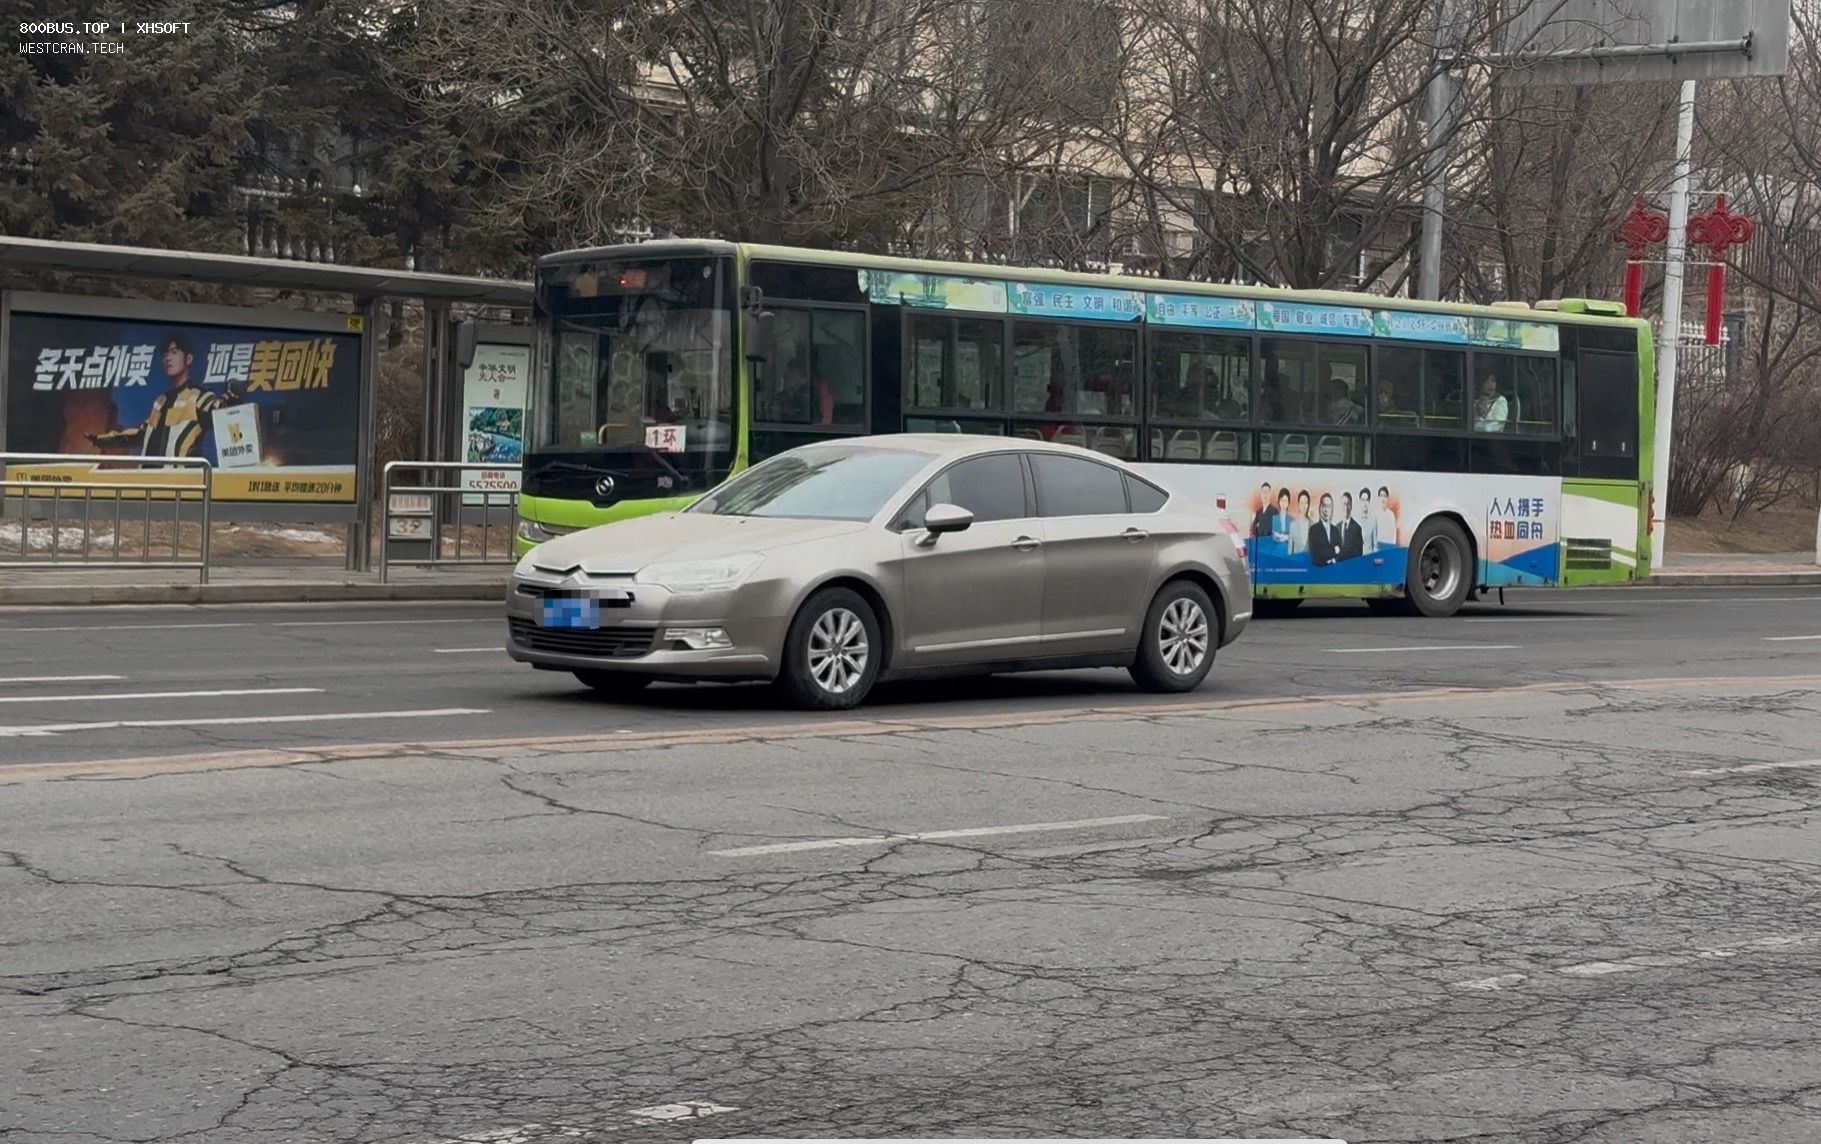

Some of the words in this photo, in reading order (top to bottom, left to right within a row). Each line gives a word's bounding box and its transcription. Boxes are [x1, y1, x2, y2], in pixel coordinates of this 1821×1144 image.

[1053, 293, 1074, 309] 民主
[1083, 295, 1103, 310] 文明
[1205, 305, 1221, 319] 公正
[32, 344, 156, 391] 冬天点外卖
[203, 337, 338, 392] 还是美团快
[479, 363, 516, 374] 中华文明
[1490, 497, 1544, 517] 人人携手
[1490, 520, 1543, 540] 热血同舟
